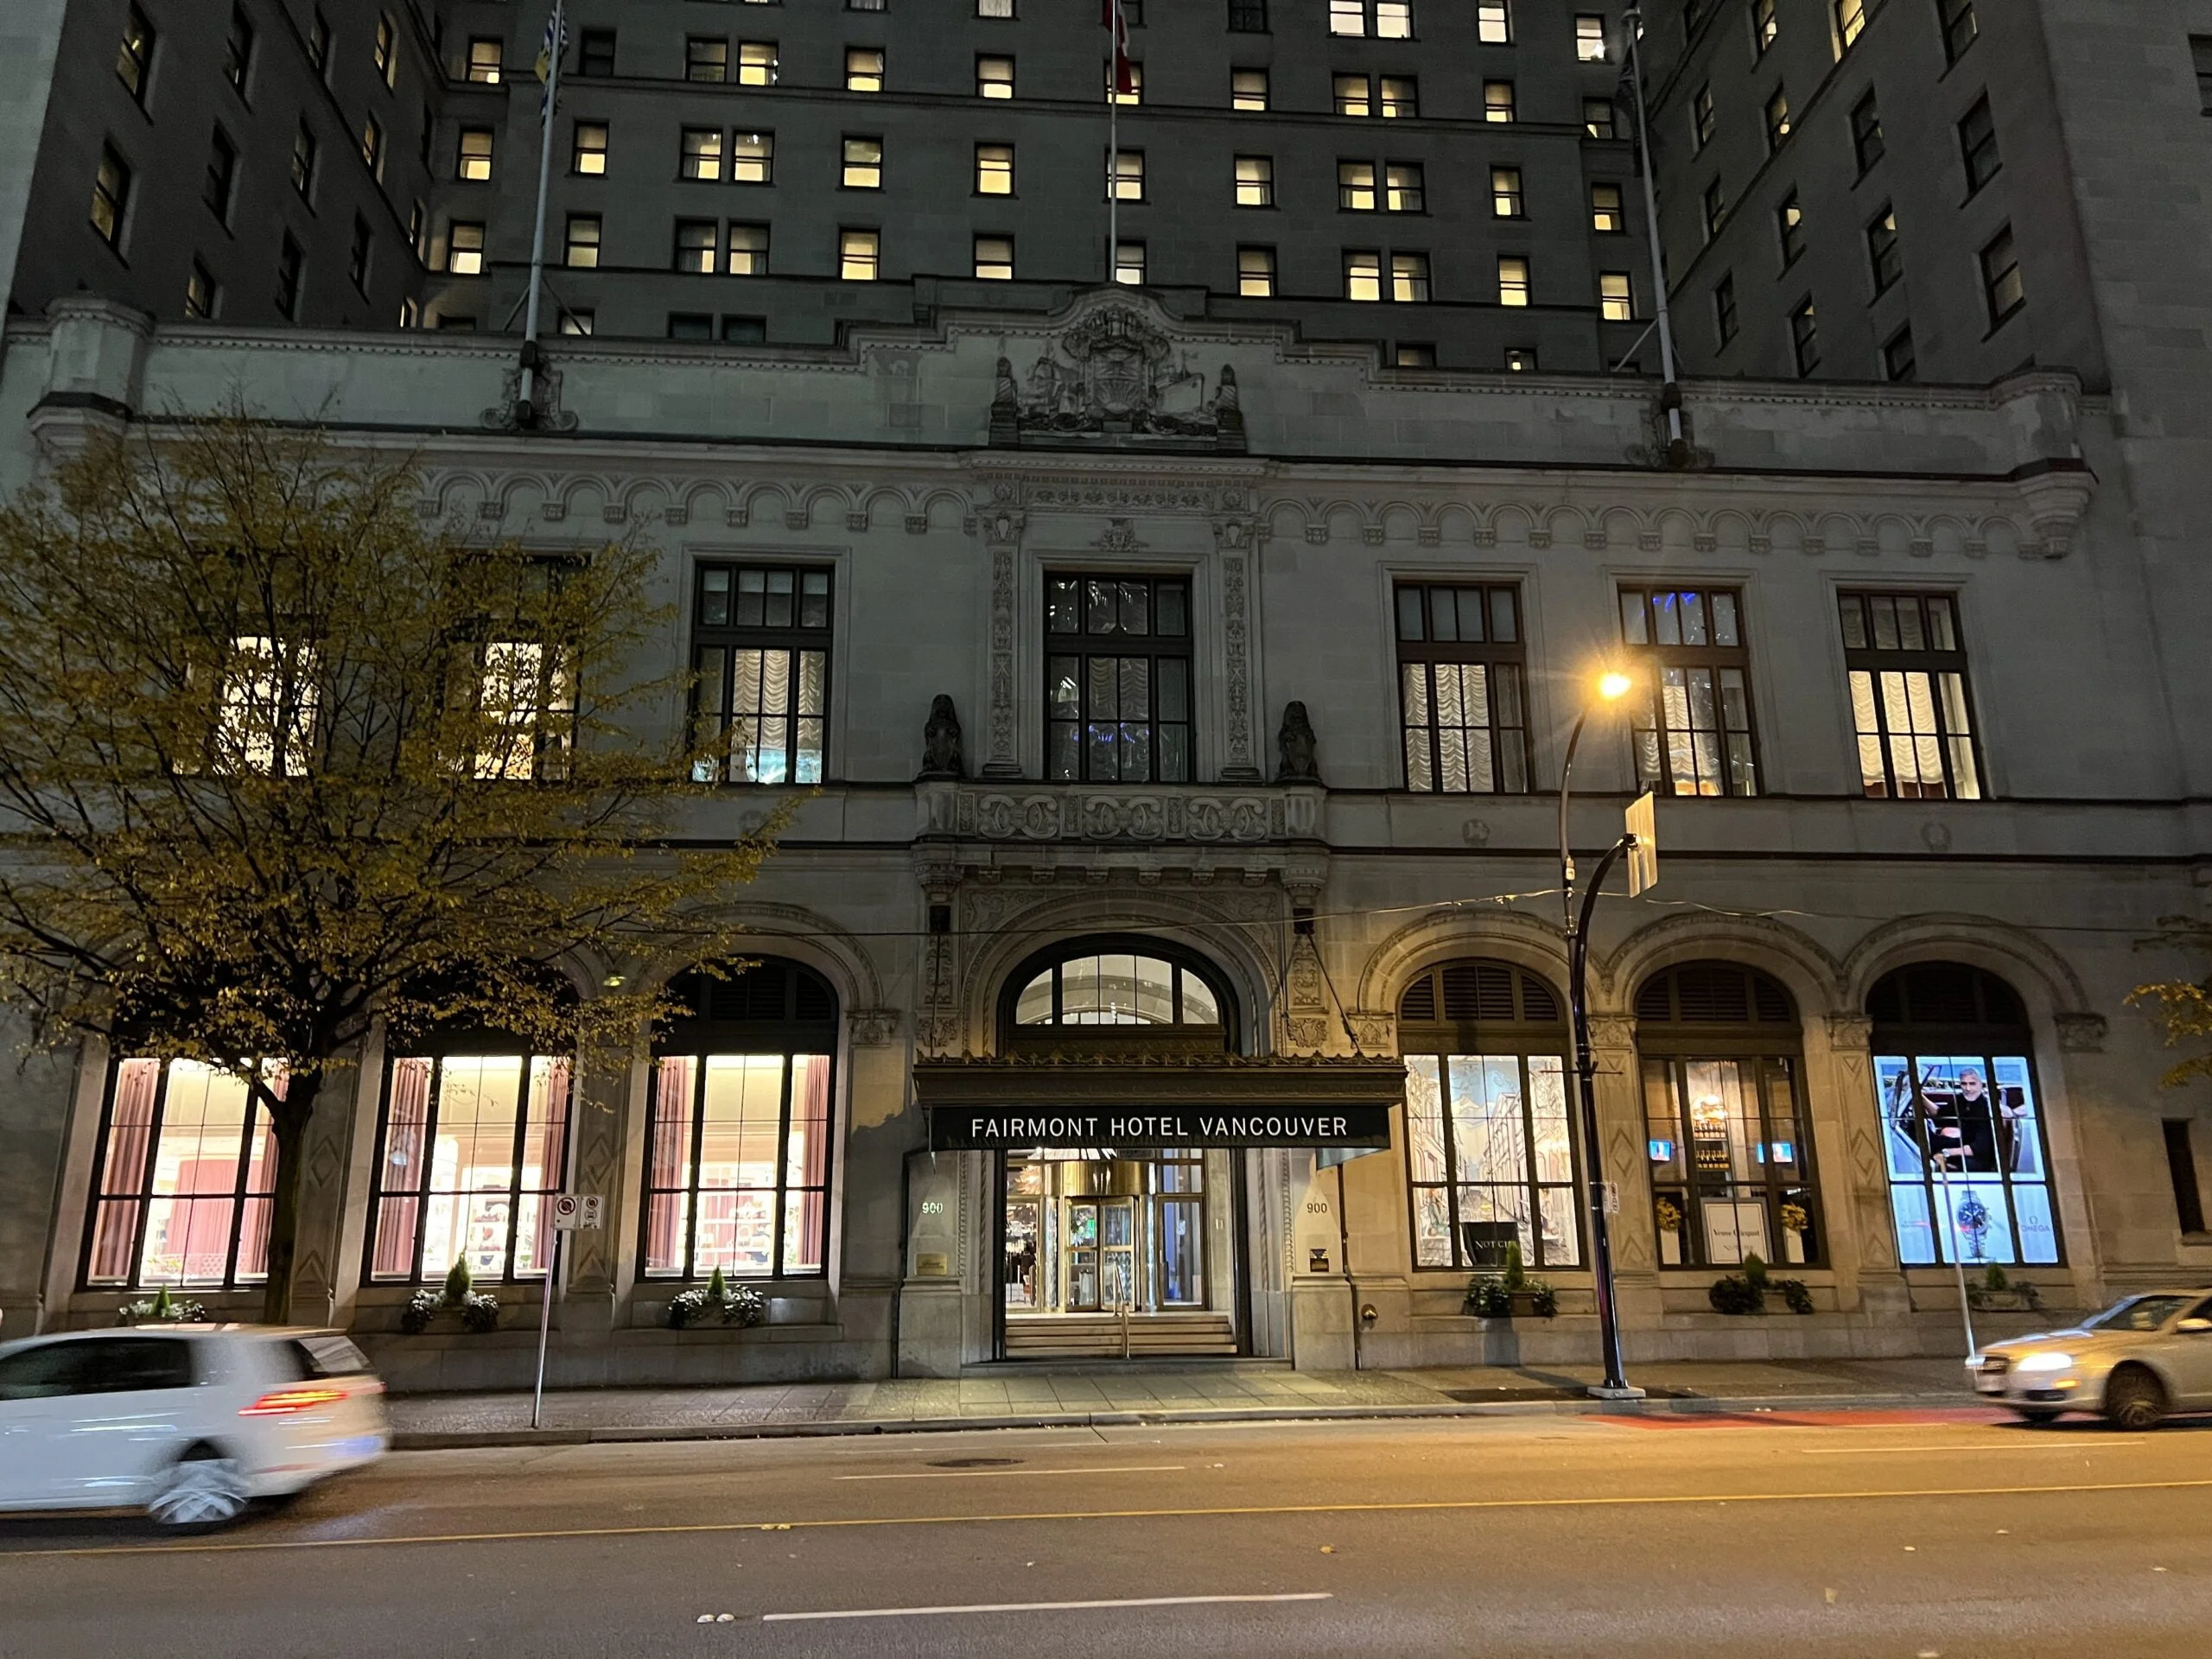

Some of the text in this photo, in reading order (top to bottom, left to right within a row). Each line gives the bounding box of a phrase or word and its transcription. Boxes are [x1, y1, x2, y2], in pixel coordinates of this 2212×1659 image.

[972, 1116, 1348, 1138] FAIRMONT HOTEL VANCOUVER
[922, 1202, 944, 1214] 900
[1306, 1203, 1327, 1213] 900
